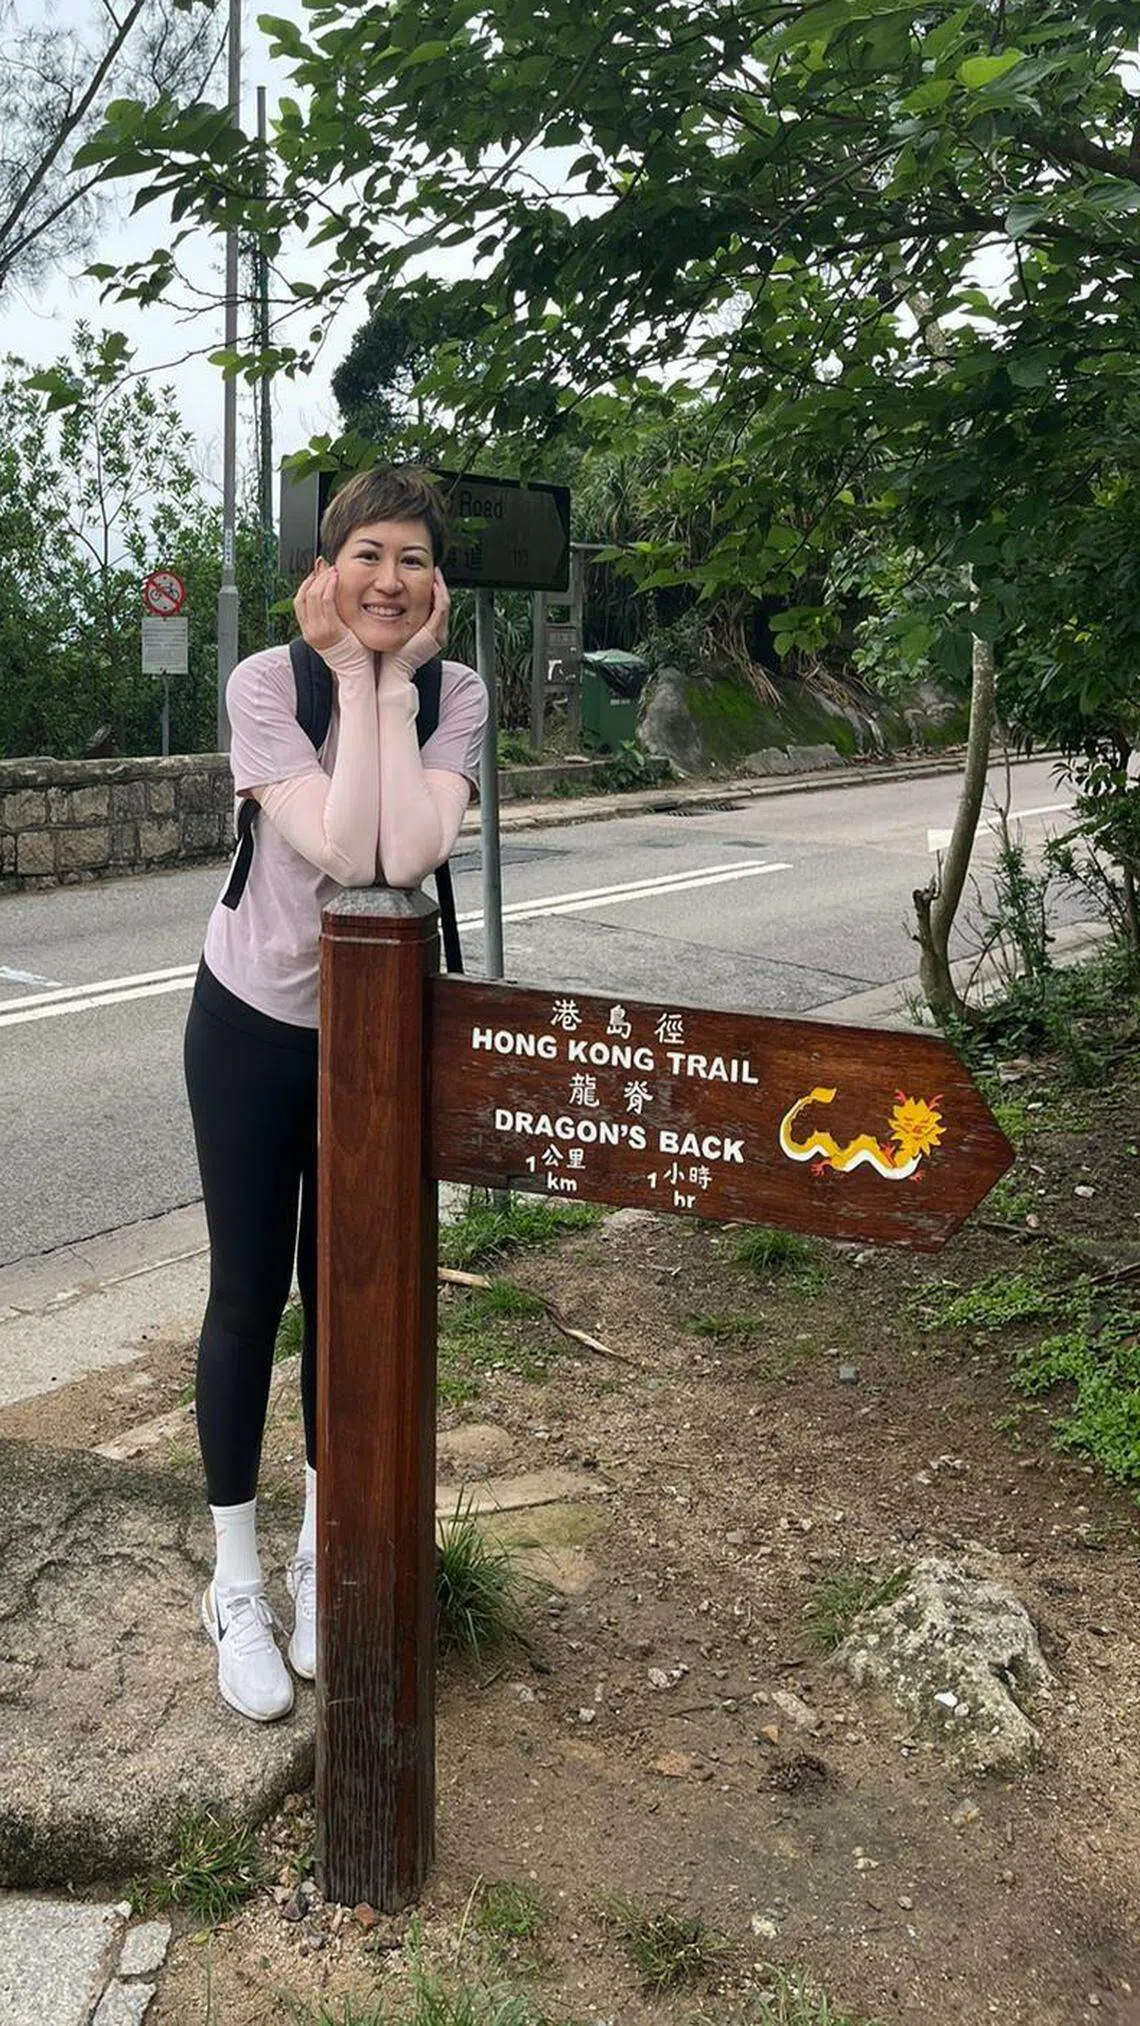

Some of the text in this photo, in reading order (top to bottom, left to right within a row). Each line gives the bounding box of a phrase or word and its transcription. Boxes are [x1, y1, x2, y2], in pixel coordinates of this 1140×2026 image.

[459, 490, 503, 518] Road
[551, 999, 685, 1045] 港島徑
[472, 1027, 759, 1084] HONG KONG TRAIL
[568, 1072, 654, 1115] 龍脊
[495, 1108, 745, 1163] DRAGON'S BACK
[525, 1143, 586, 1173] 1 公里
[547, 1171, 577, 1192] km
[647, 1162, 712, 1190] 1 小時
[673, 1190, 696, 1209] hr
